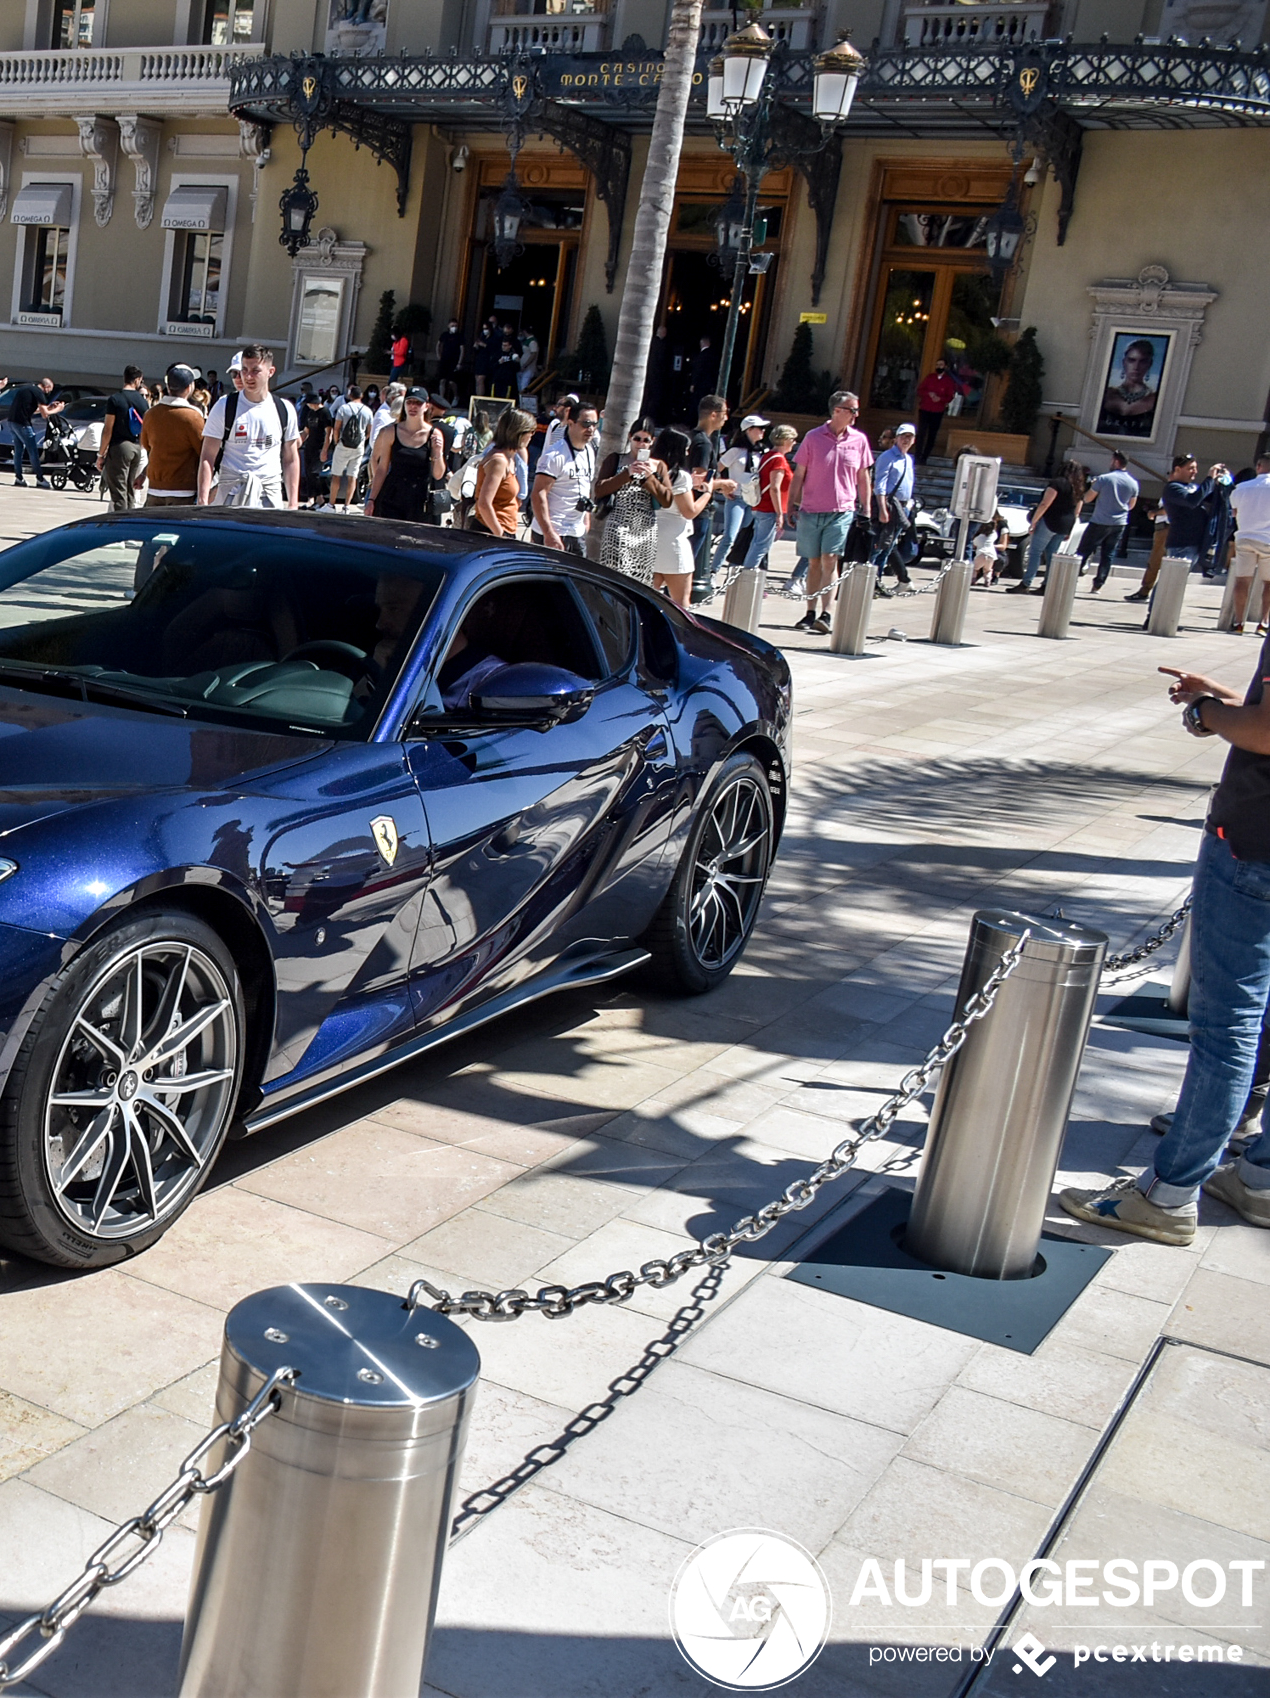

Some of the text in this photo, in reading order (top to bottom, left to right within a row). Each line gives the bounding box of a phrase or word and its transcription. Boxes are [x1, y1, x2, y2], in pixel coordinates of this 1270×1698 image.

[600, 63, 665, 74] CASINO
[560, 72, 703, 86] MONTE-CAO
[20, 215, 43, 223] OMEGA
[171, 219, 197, 227] OMEGA
[28, 316, 50, 325] OMEGA
[177, 326, 202, 335] OMEGA
